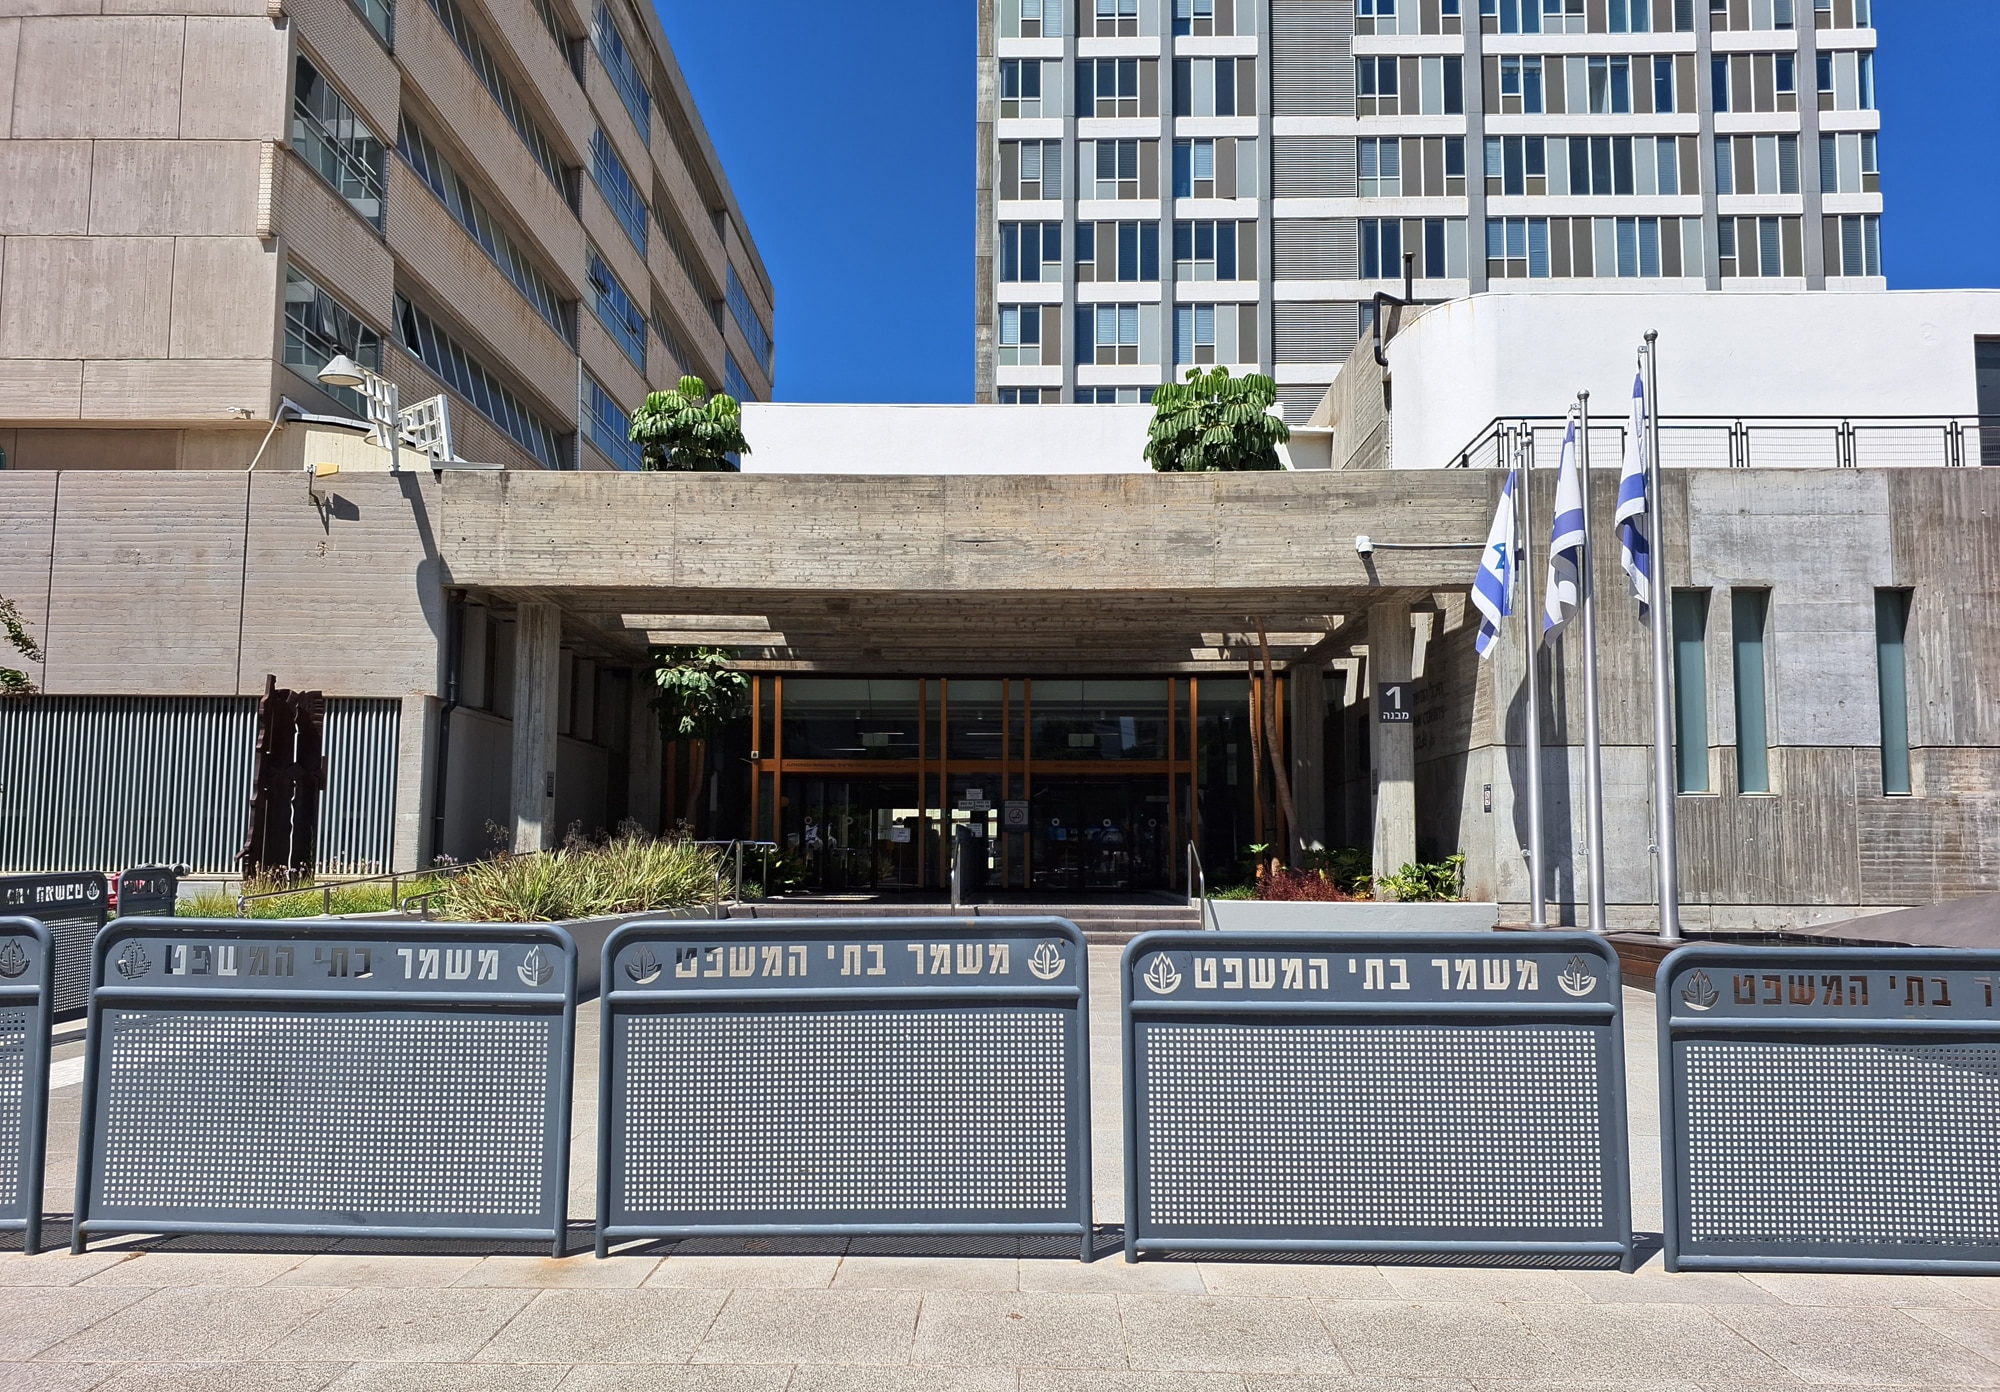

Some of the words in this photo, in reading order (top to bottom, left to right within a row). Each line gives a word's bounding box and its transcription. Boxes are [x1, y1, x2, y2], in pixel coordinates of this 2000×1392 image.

[1385, 686, 1401, 709] 1
[1382, 711, 1410, 720] מבנה
[164, 944, 295, 977] המשפט
[314, 946, 374, 978] בתי
[396, 948, 499, 980] משמר
[674, 945, 808, 979] המשפט
[827, 944, 887, 976] בתי
[907, 943, 1010, 975] משמר
[1193, 957, 1329, 990] המשפט
[1348, 958, 1411, 991] בתי
[1431, 959, 1540, 991] משמר
[1732, 974, 1870, 1006] המשפט
[1888, 975, 1953, 1007] בתי
